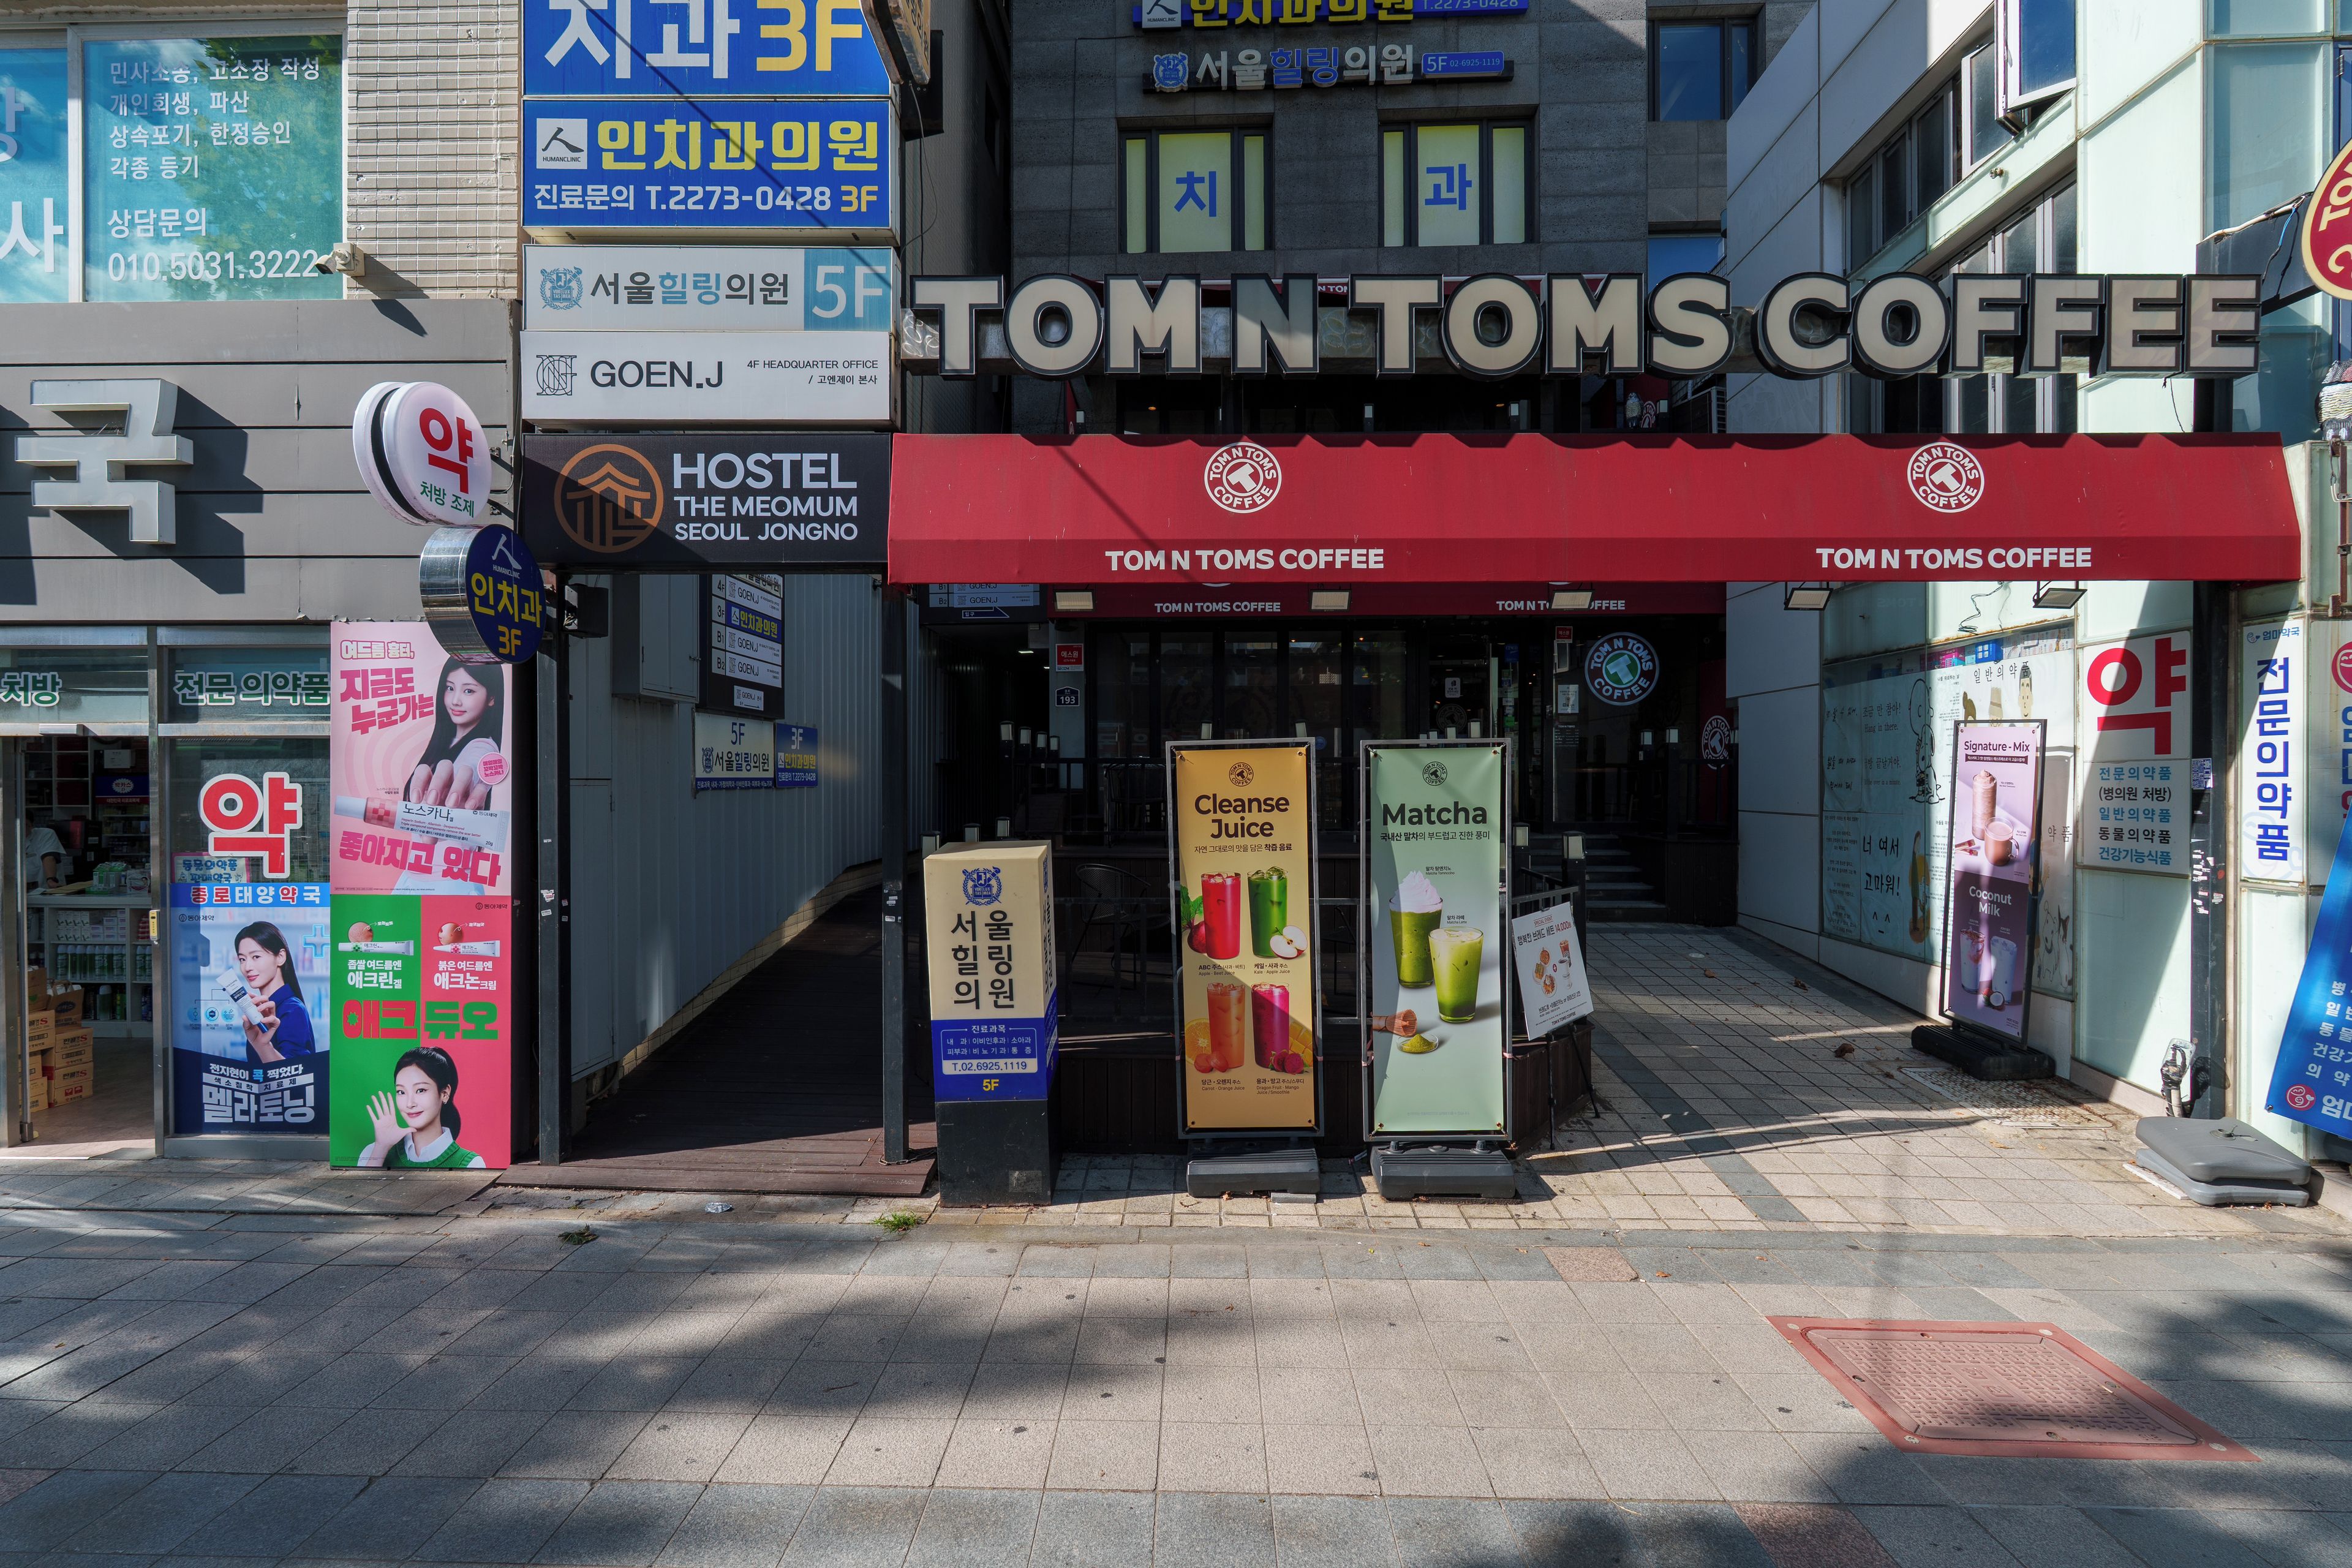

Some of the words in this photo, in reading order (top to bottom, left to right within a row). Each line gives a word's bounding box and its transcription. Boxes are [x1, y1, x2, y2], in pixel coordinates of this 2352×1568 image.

[756, 0, 862, 71] 3F
[110, 60, 198, 85] 민사소송,
[209, 58, 270, 81] 고소장
[281, 56, 320, 81] 작성
[1196, 44, 1413, 90] 서울힐링의원
[1427, 56, 1447, 72] 5F
[1450, 58, 1501, 67] 02-6925-1119
[110, 91, 198, 116] 개인회생,
[210, 91, 249, 115] 파산
[110, 124, 198, 149] 상속포기,
[210, 121, 291, 147] 한정승인
[597, 119, 878, 172] 인치과의원
[110, 156, 149, 181] 각종
[159, 156, 200, 179] 등기
[535, 184, 635, 211] 진료문의
[645, 185, 831, 211] T.2273-0428
[840, 186, 878, 213] 3F
[108, 207, 207, 239] 상담문의
[108, 249, 320, 284] 010.5031.3222
[592, 271, 788, 306] 서울힐링의원
[812, 265, 887, 318] 5F
[911, 273, 1200, 380] TOM
[1231, 273, 1318, 378] N
[1349, 273, 1734, 381] TOMS
[1752, 273, 2262, 380] COFFEE
[590, 361, 723, 388] GOEN.J
[747, 360, 760, 369] 4F
[763, 360, 839, 369] HEADQUARTER
[842, 360, 878, 369] OFFICE
[817, 374, 854, 385] 고엔제이
[858, 374, 877, 385] 본사
[15, 379, 193, 544] 국
[420, 408, 473, 494] 약
[673, 453, 858, 488] HOSTEL
[420, 480, 447, 507] 처방
[451, 493, 475, 518] 조제
[674, 496, 725, 516] THE
[731, 496, 858, 516] MEOMUM
[674, 522, 749, 540] SEOUL
[757, 522, 858, 540] JONGNO
[1105, 549, 1166, 570] TOM
[1170, 549, 1191, 570] N
[1195, 548, 1275, 570] TOMS
[1279, 548, 1384, 569] COFFEE
[471, 573, 542, 623] 인치과
[717, 579, 725, 592] 4F
[737, 586, 759, 605] GOEN.J
[1155, 603, 1183, 612] TOM
[1185, 603, 1193, 612] N
[1195, 602, 1231, 612] TOMS
[1232, 601, 1280, 612] COFFEE
[717, 605, 725, 617] 3F
[739, 611, 778, 638] 인치과의원
[499, 625, 521, 655] 3F
[717, 630, 725, 643] B1
[737, 636, 759, 653] GOEN.J
[2262, 627, 2300, 641] 엄마약국
[341, 640, 385, 660] 여드름
[387, 641, 415, 659] 흉터,
[717, 657, 725, 671] B2
[737, 662, 760, 677] GOEN.J
[1, 673, 59, 706] 처방
[174, 673, 236, 706] 전문
[244, 672, 331, 706] 의약품
[341, 667, 415, 703] 지금도
[2087, 637, 2186, 755] 약
[1060, 696, 1076, 704] 193
[352, 695, 434, 735] 누군가는
[731, 722, 745, 745] 5F
[791, 728, 803, 750] 3F
[1964, 740, 2007, 753] Signature
[2013, 741, 2030, 752] Mix
[715, 751, 769, 772] 서울힐링의원
[785, 753, 816, 769] 인치과의원
[2256, 657, 2291, 861] 전문의약품
[793, 772, 816, 781] T.2273-0428
[2099, 766, 2171, 781] 전문의약품
[1194, 793, 1289, 815] Cleanse
[2098, 786, 2138, 801] (병의원
[2143, 787, 2171, 802] 처방)
[201, 772, 301, 877] 약
[1382, 801, 1487, 826] Matcha
[2099, 807, 2171, 823] 일반의약품
[1210, 816, 1274, 839] Juice
[1380, 832, 1402, 842] 국내산
[1404, 832, 1425, 841] 말차의
[1428, 831, 1457, 840] 부드럽고
[1459, 831, 1474, 840] 진한
[1476, 831, 1490, 840] 풍미
[2098, 827, 2171, 843] 동물의약품
[339, 831, 435, 875] 좋아지고
[441, 846, 502, 887] 있다
[1194, 845, 1207, 854] 자연
[2099, 846, 2172, 865] 건강기능식품
[183, 859, 238, 870] 동물의약품
[191, 886, 321, 905] 종로태양약국
[1864, 873, 1899, 896] 고마워!
[1969, 886, 2012, 905] Coconut
[1979, 902, 2000, 917] Milk
[348, 960, 366, 970] 좁쌀
[367, 960, 402, 971] 여드름엔
[439, 960, 456, 971] 붉은
[457, 960, 492, 971] 여드름엔
[971, 1025, 1006, 1033] 진료과목
[209, 1063, 249, 1080] 전지현이
[253, 1069, 263, 1082] 콕
[267, 1064, 303, 1079] 찍었다
[952, 1061, 1027, 1071] T.02.6925.1119
[214, 1077, 254, 1091] 색소침착
[264, 1078, 296, 1090] 치료제
[982, 1079, 1000, 1091] 5F
[203, 1085, 315, 1123] 멜라토닝
